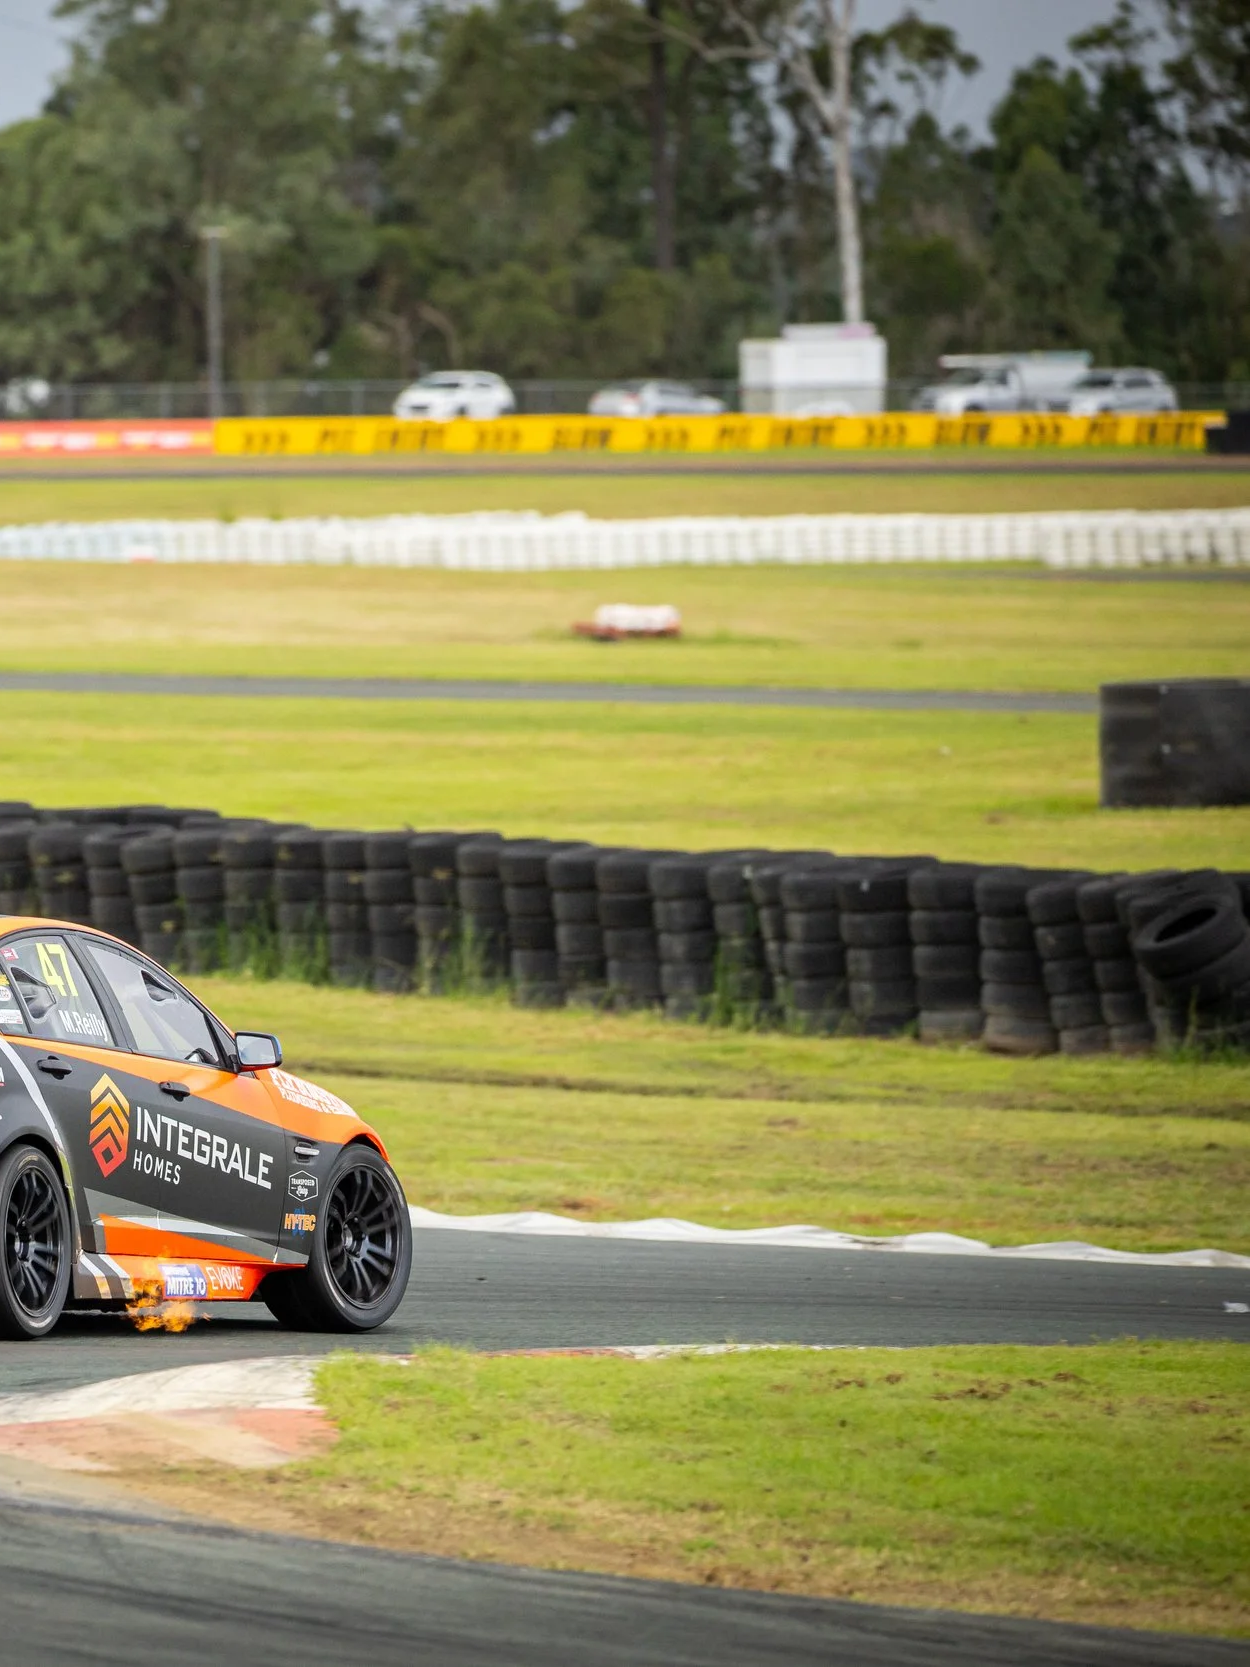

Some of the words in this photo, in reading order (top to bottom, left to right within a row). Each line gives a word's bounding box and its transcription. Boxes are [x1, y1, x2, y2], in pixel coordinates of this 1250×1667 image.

[35, 942, 79, 997] 47
[58, 1009, 109, 1042] M.Reilly
[136, 1106, 274, 1190] INTEGRALE
[133, 1149, 182, 1185] HOMES
[166, 1276, 195, 1296] MITRE
[195, 1278, 207, 1297] 10
[205, 1265, 244, 1291] EVOKE
